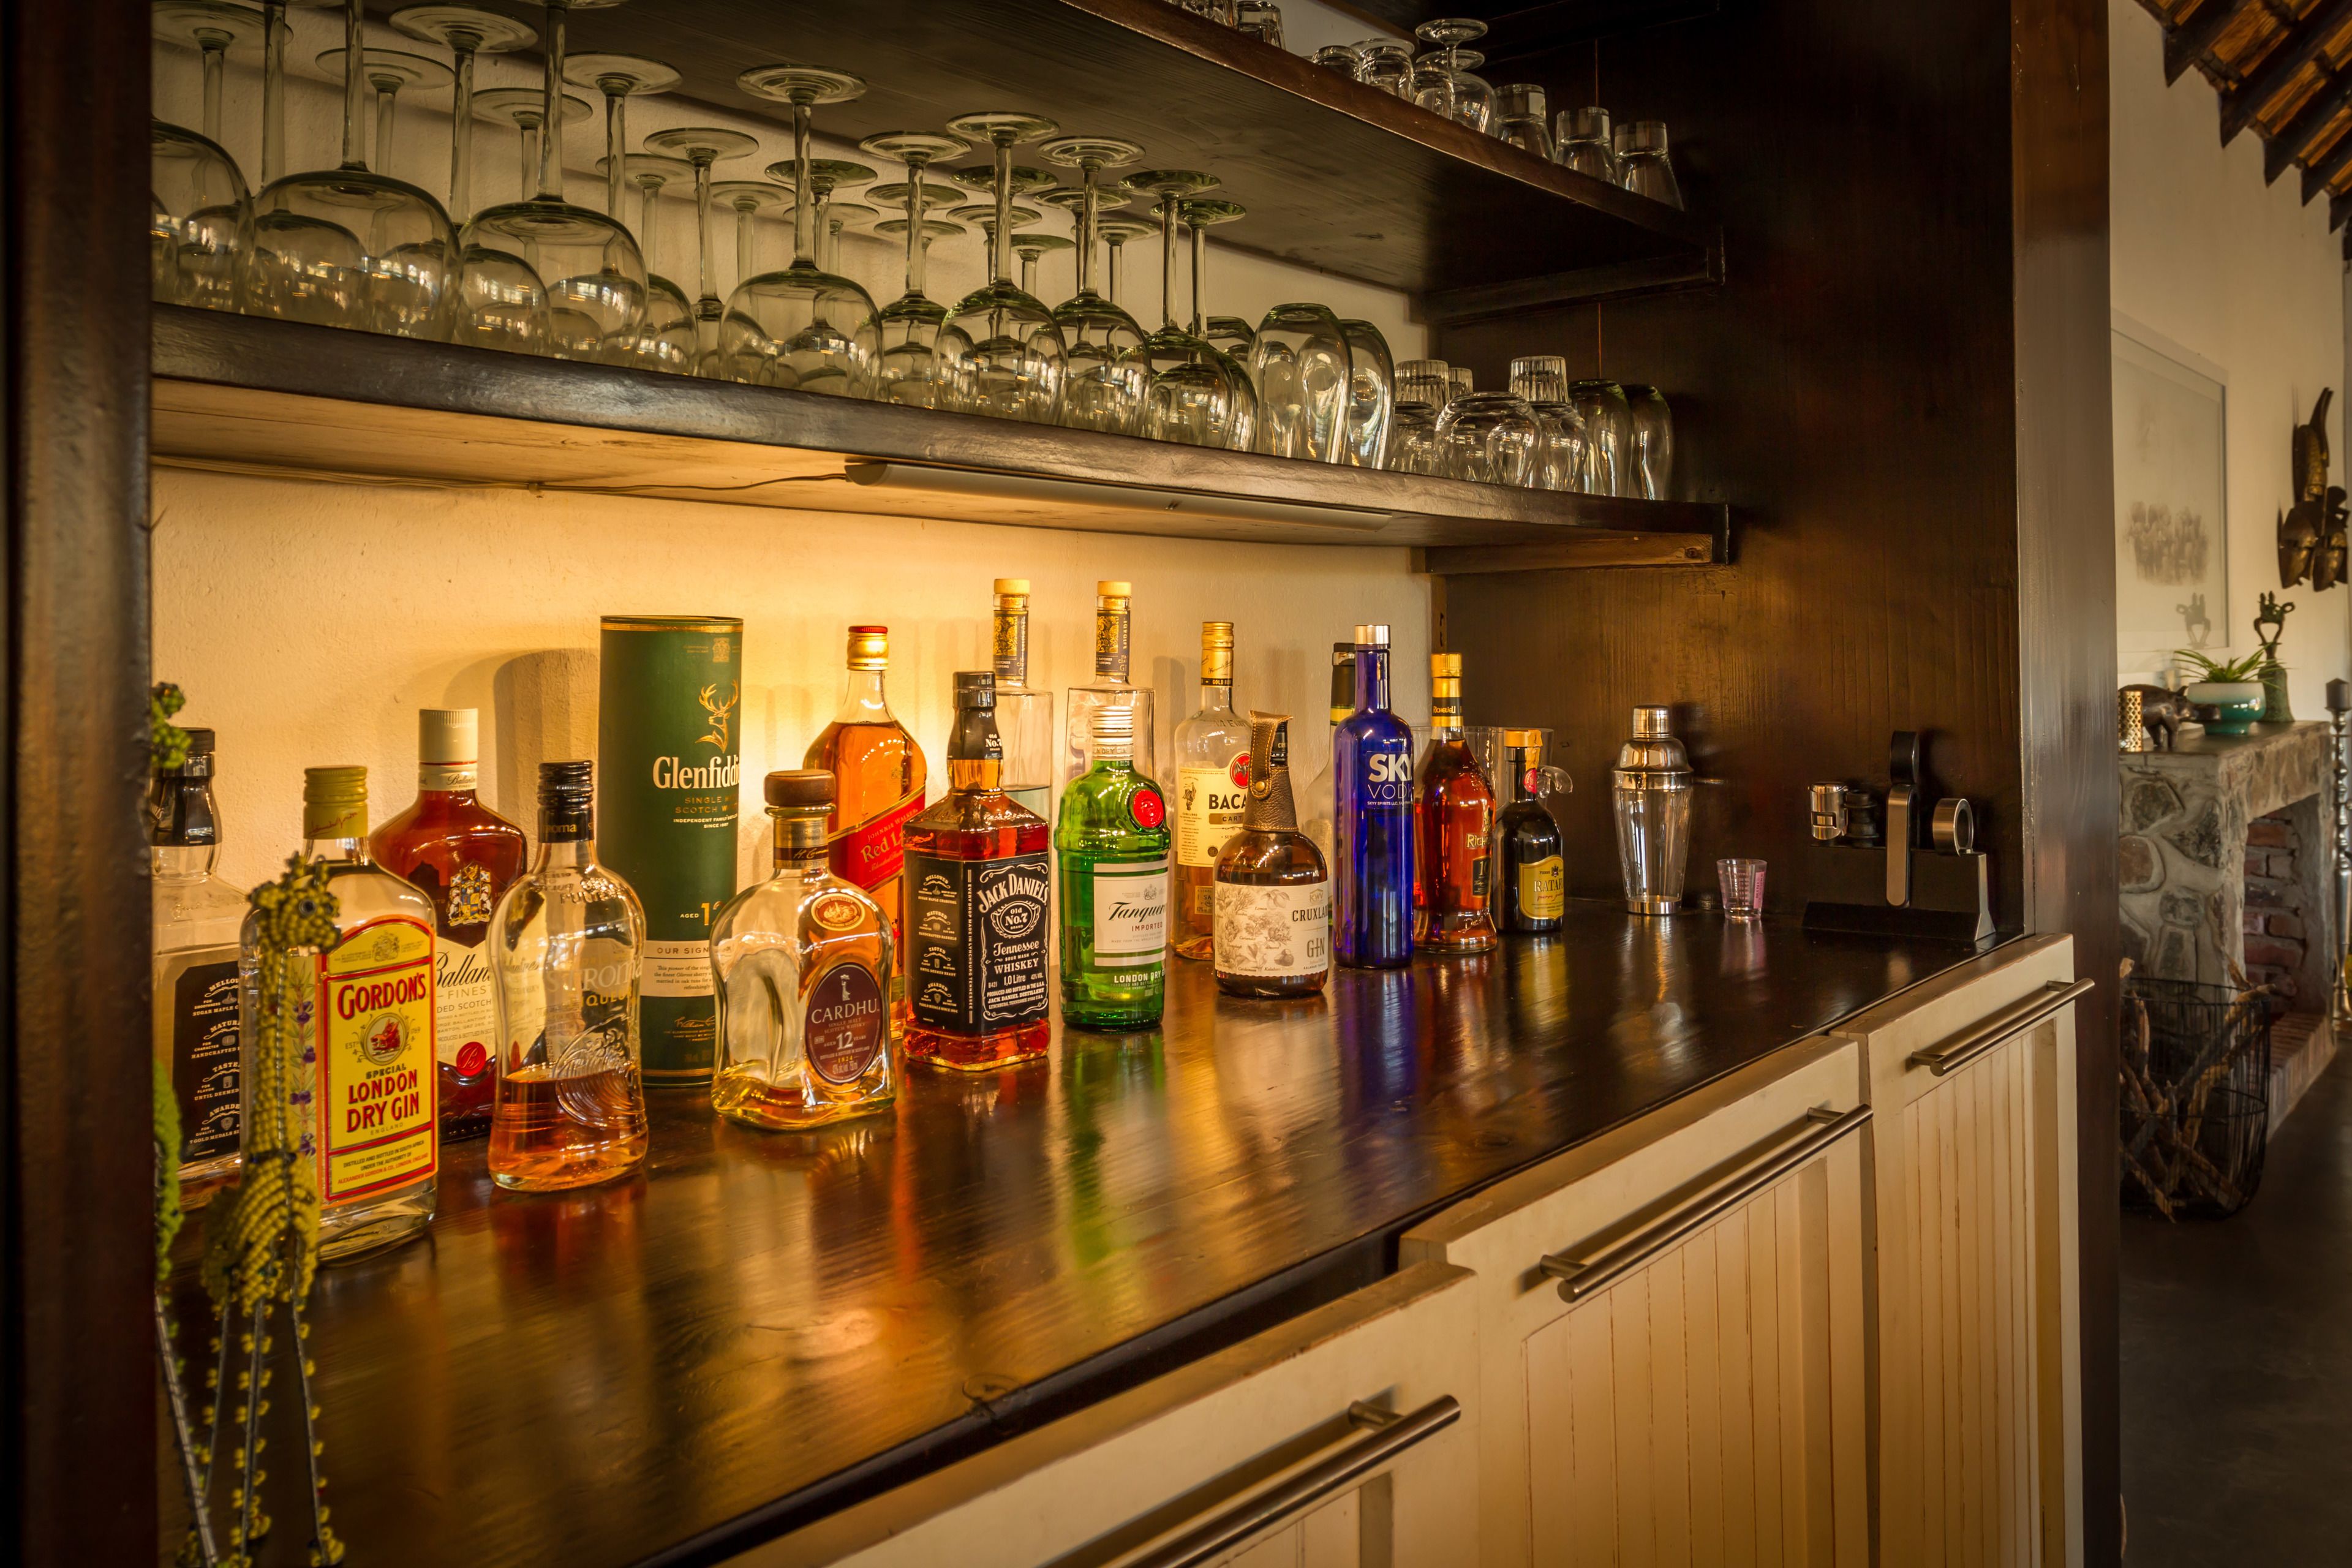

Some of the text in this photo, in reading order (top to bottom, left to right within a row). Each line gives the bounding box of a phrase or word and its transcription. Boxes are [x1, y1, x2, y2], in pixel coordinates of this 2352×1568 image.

[867, 823, 894, 842] JOHNNIE
[861, 836, 891, 864] Red
[976, 873, 1049, 913] JACK DANIEL'S
[927, 910, 948, 919] MATURED
[1005, 913, 1028, 926] No.7
[1132, 922, 1163, 932] IMPORTED
[993, 941, 1039, 957] Tennessee
[1307, 937, 1325, 958] GIN
[994, 958, 1039, 974] WHISKEY
[1012, 974, 1026, 985] Litre
[1114, 970, 1161, 984] LONDON DRY
[927, 982, 948, 992] AWARDED
[987, 989, 1005, 998] PRODUCED
[1001, 993, 1019, 1002] DANIEL
[1019, 988, 1045, 998] DISTILLERY
[337, 973, 426, 1020] GORDON'S
[458, 998, 492, 1011] SCOTCH
[192, 1008, 212, 1017] SUGAR
[811, 998, 878, 1024] CARDHU
[836, 1031, 854, 1050] 12
[191, 1047, 236, 1059] HANDCRAFTED
[365, 1063, 407, 1079] SPECIAL
[214, 1088, 239, 1097] DEEMED
[348, 1069, 418, 1104] LONDON
[346, 1091, 420, 1133] DRY GIN
[209, 1131, 232, 1140] MEDALS
[370, 1122, 404, 1136] ENGLAND
[343, 1157, 366, 1169] DISTILLED
[365, 1154, 376, 1163] AND
[375, 1150, 394, 1160] BOTTLED
[399, 1144, 413, 1153] SOUTH
[412, 1140, 425, 1149] AFRICA
[360, 1161, 375, 1172] UNDER
[384, 1153, 406, 1165] AUTHORITY
[337, 1172, 364, 1185] ALEXANDER
[364, 1167, 383, 1177] GORDON
[412, 1152, 429, 1163] ENGLAND
